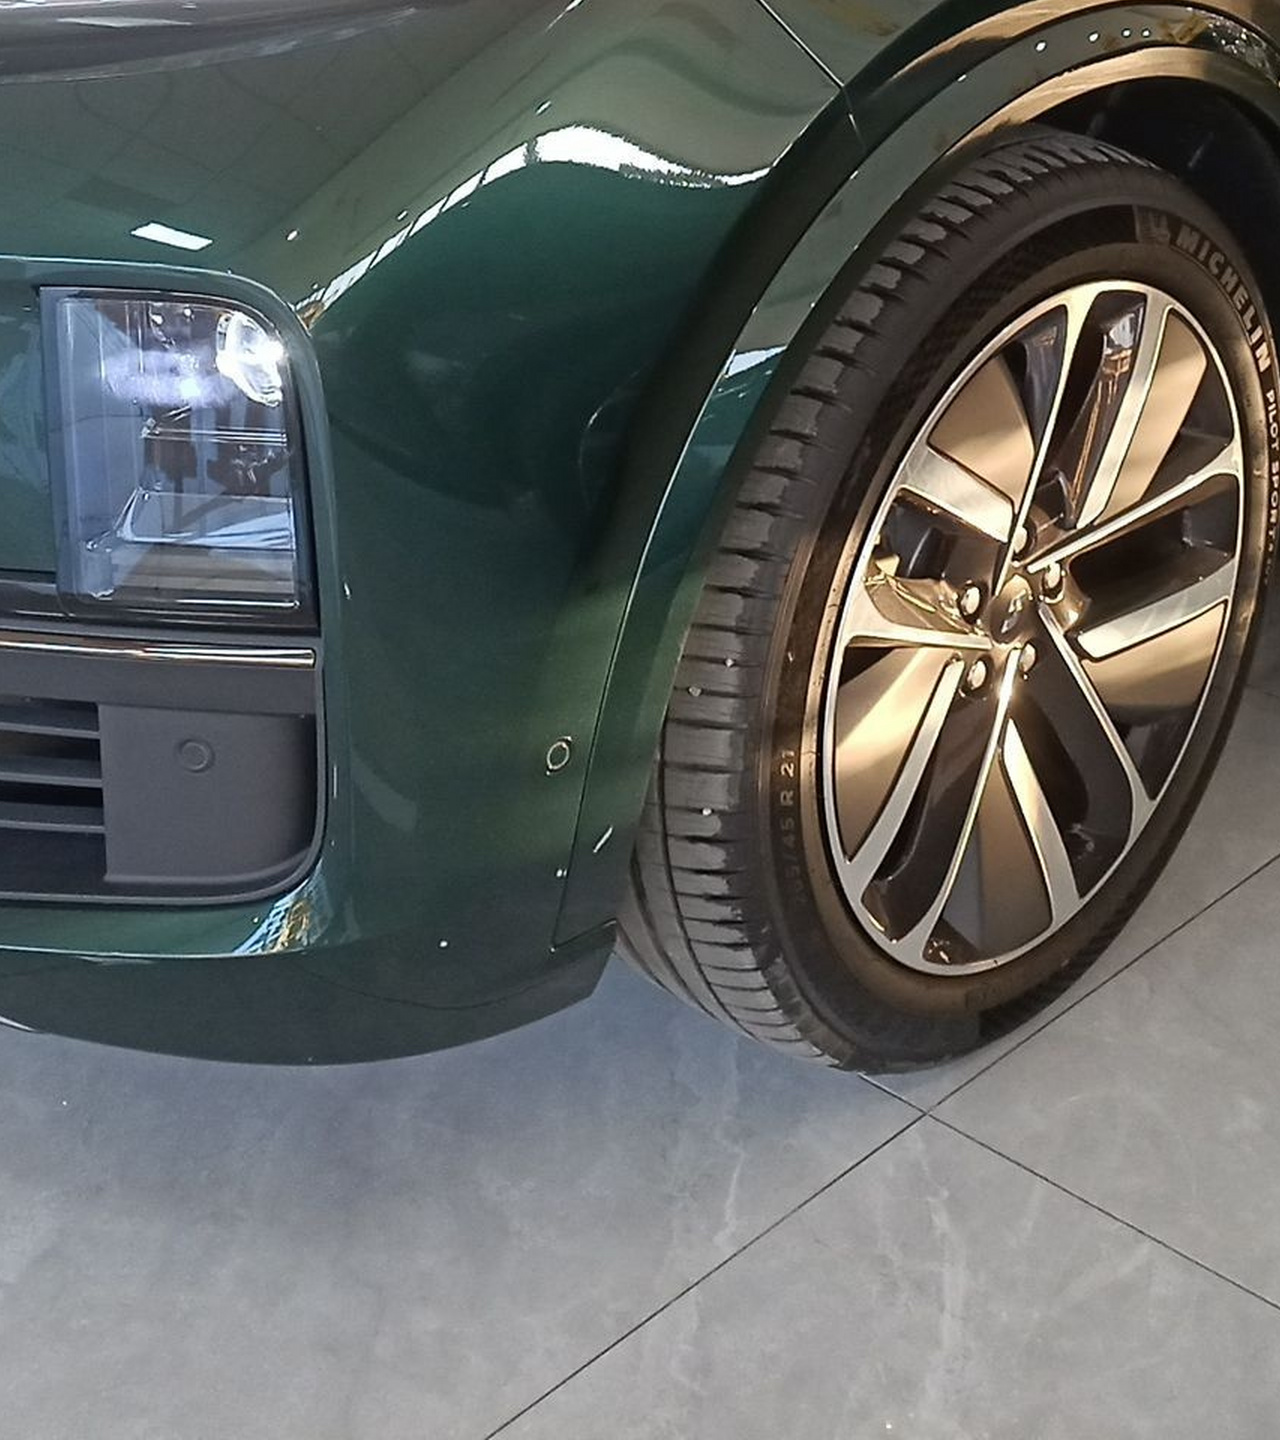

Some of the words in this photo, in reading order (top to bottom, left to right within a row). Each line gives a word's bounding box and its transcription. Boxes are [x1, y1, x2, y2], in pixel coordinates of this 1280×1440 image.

[1175, 224, 1272, 373] MICHELIN
[1265, 389, 1280, 451] PILOT
[1268, 460, 1280, 540] SPORT
